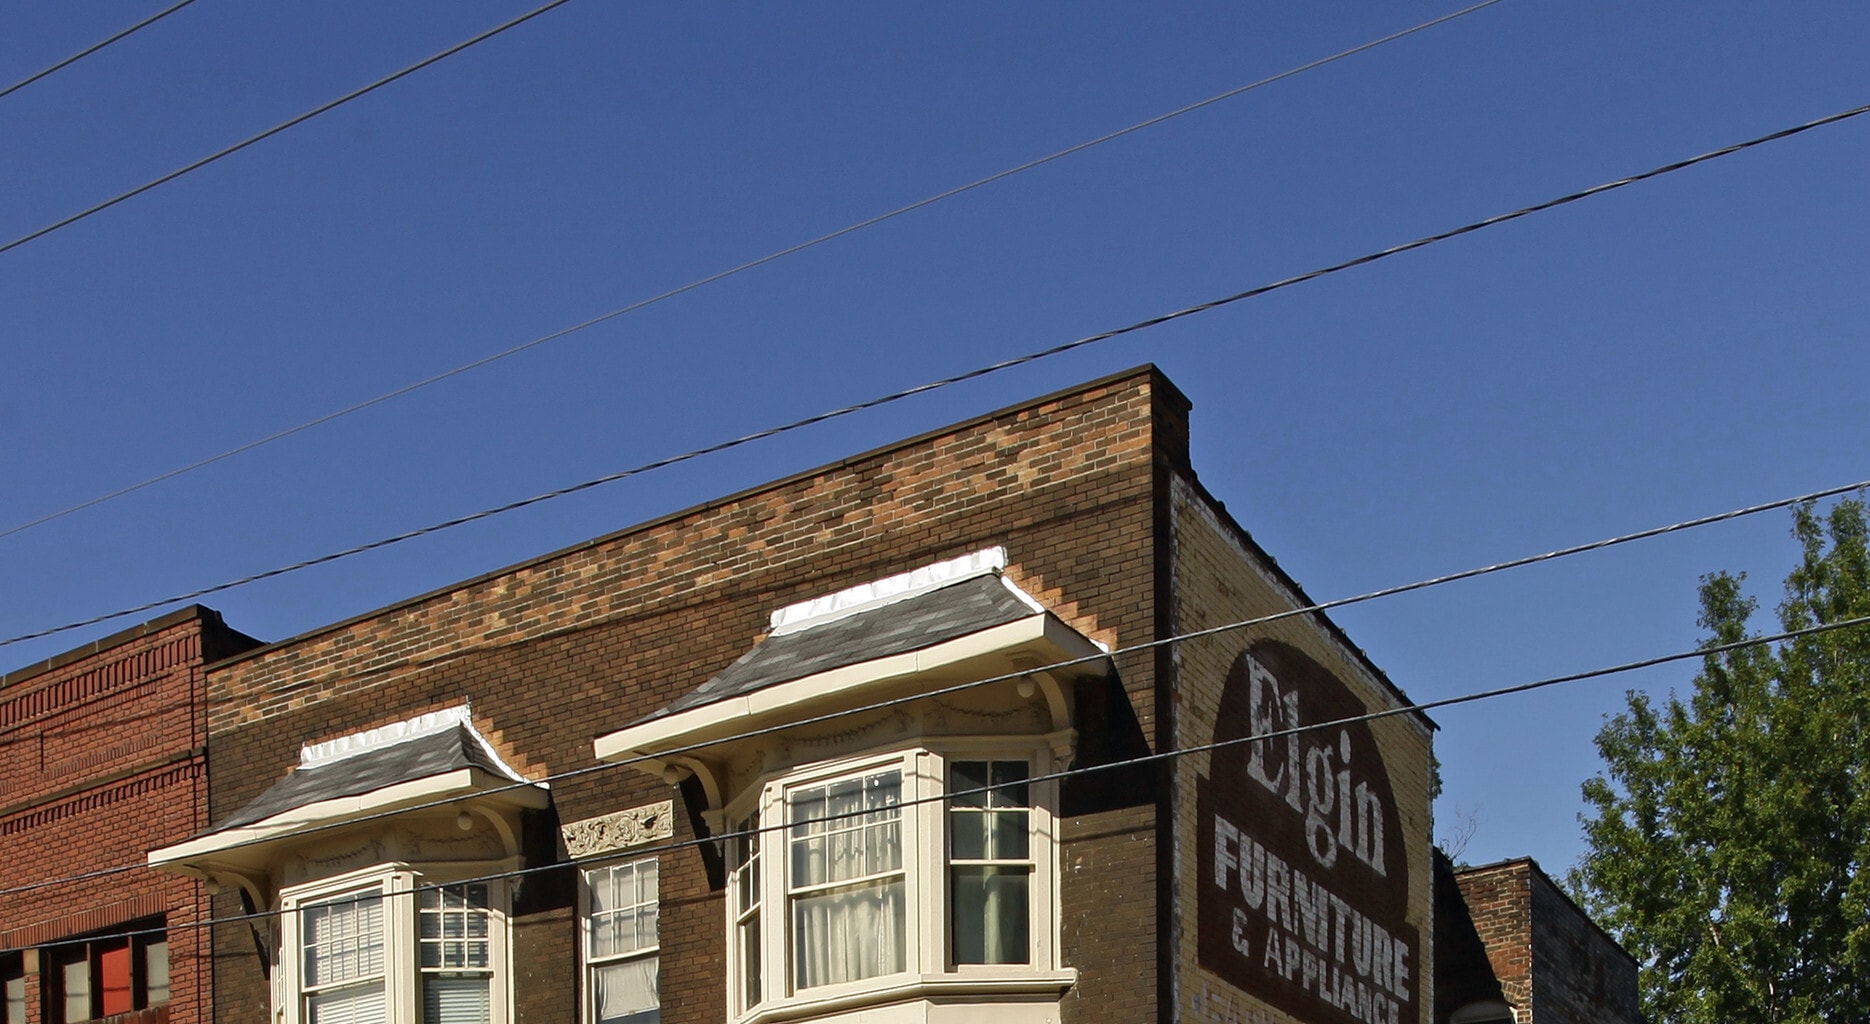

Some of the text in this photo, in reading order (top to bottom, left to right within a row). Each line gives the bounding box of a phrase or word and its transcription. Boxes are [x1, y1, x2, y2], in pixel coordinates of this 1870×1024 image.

[1246, 653, 1387, 877] Elgin
[1214, 813, 1409, 1001] FURNITURE
[1232, 907, 1249, 957] &
